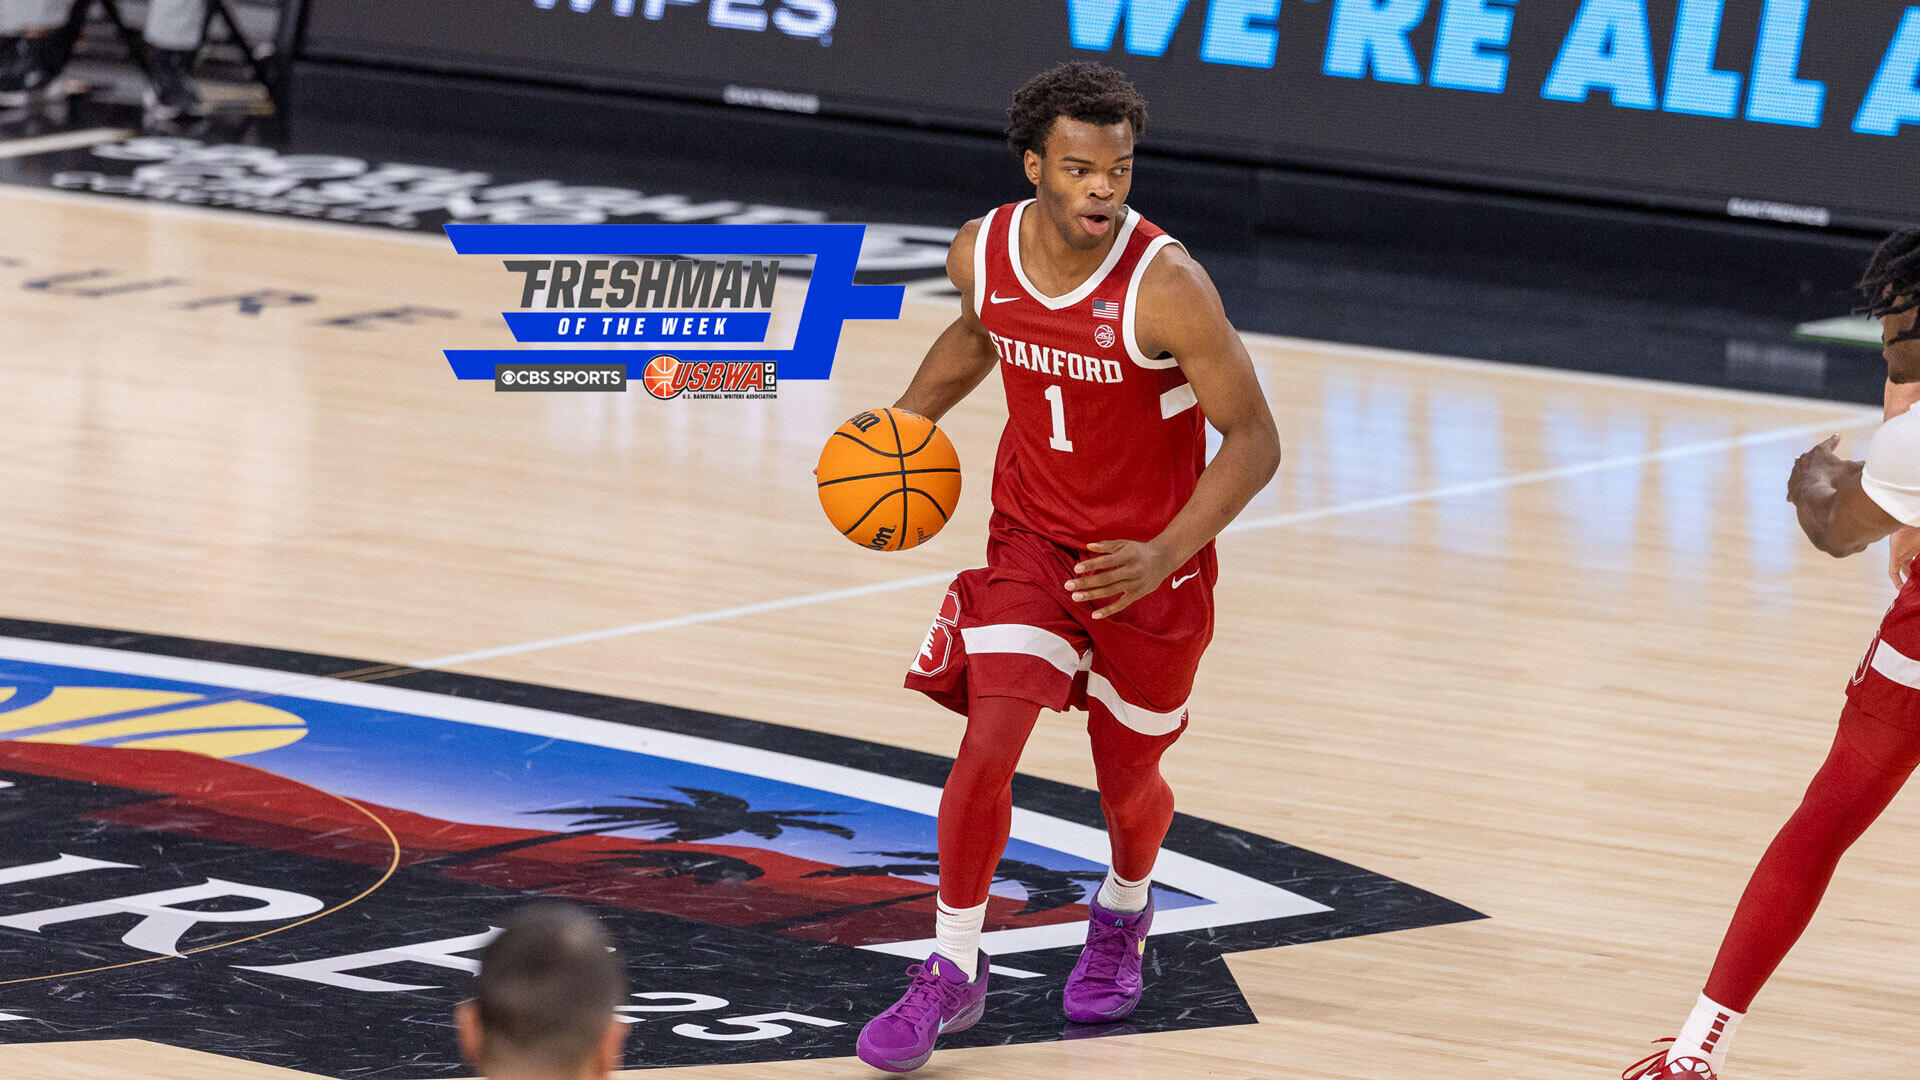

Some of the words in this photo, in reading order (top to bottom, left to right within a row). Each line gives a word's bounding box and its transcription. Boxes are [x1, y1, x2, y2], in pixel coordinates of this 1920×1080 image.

[1540, 0, 1827, 128] ALL
[988, 331, 1124, 384] STANFORD
[1044, 384, 1074, 453] 1
